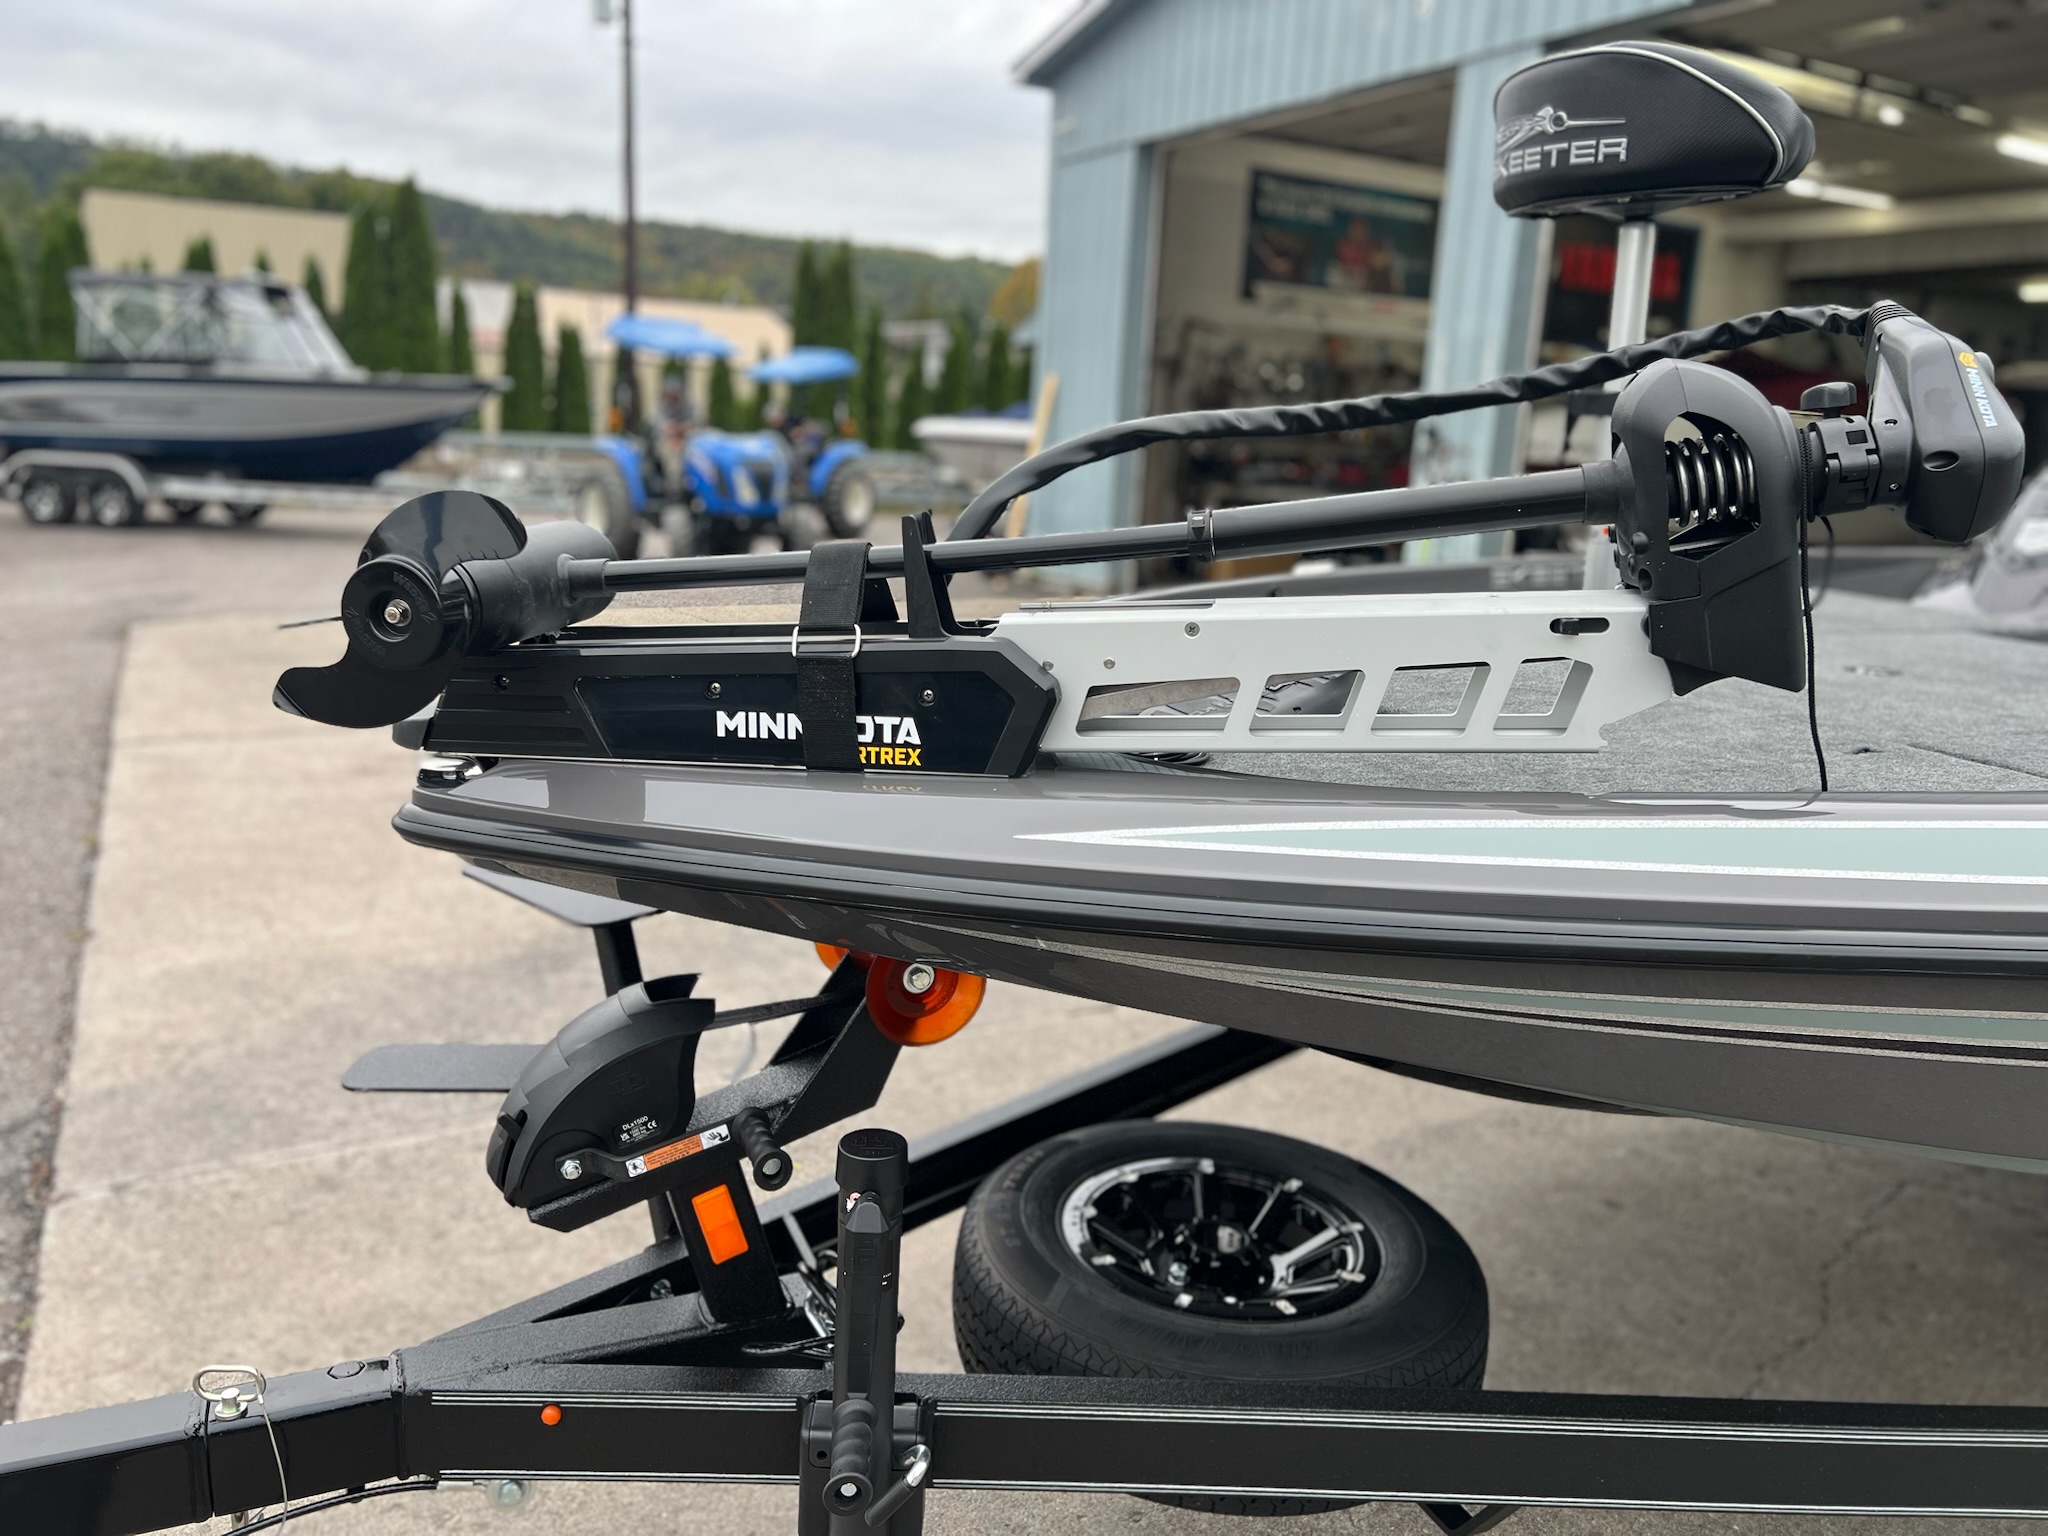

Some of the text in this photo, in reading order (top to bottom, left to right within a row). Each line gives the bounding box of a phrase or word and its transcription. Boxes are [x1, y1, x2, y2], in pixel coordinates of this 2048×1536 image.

[1497, 137, 1628, 177] KEETER
[1976, 398, 1998, 427] KOTA
[716, 710, 803, 740] MINN
